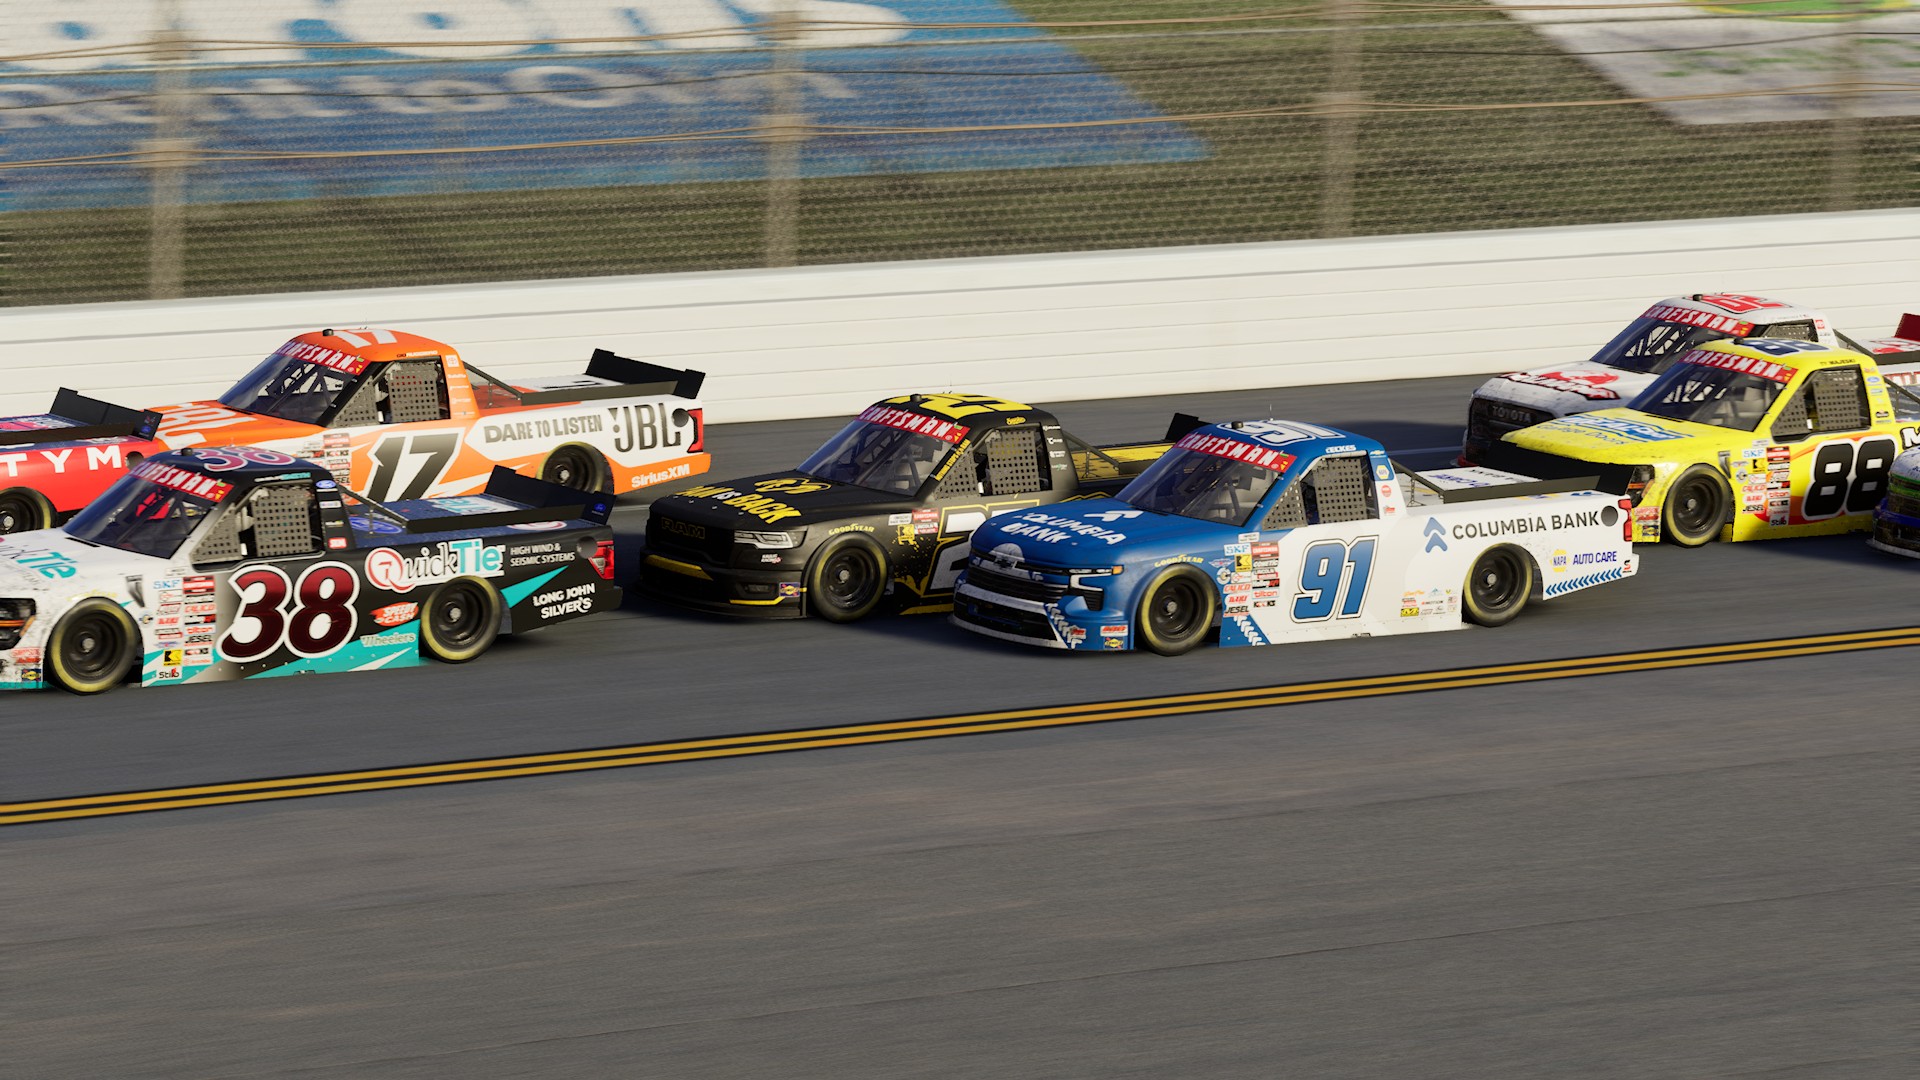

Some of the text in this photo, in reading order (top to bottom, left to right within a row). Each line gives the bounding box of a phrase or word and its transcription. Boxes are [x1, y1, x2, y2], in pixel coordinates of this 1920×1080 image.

[1650, 306, 1741, 333] CRAFTSMAN
[332, 329, 398, 348] 17
[281, 339, 355, 370] CRAFTSMAN
[1683, 350, 1785, 379] CRAFTSMAN
[859, 407, 952, 438] CRAFTSMAN
[1491, 405, 1532, 423] TOYOTA
[484, 414, 603, 444] DARE TO LISTEN
[608, 402, 681, 453] JBL
[1178, 434, 1274, 467] CRAFTSMAN
[1743, 449, 1764, 457] SKF
[131, 461, 216, 496] CRAFTSMAN
[367, 432, 461, 502] 17
[631, 463, 690, 488] SiriusXM
[1802, 439, 1896, 520] 88
[723, 493, 802, 524] BACK
[661, 517, 705, 540] RAM
[828, 523, 875, 536] GOODYEAR
[1452, 510, 1600, 540] COLUMBIA BANK
[510, 552, 576, 567] SEISMIC SYSTEMS
[511, 543, 562, 556] HIGH WIND &
[1154, 554, 1204, 567] GOODYEAR
[1226, 545, 1249, 553] SKF
[1553, 550, 1617, 567] NAPA AUTO CARE
[153, 580, 180, 589] SKF
[1224, 584, 1250, 592] CALICO
[1290, 535, 1379, 624] 91
[533, 583, 595, 606] LONG JOHN
[215, 561, 361, 663] 38
[383, 602, 417, 617] SPEEDY
[386, 612, 415, 624] CASH
[540, 597, 593, 619] SILVER'S
[361, 632, 416, 647] Wheelers
